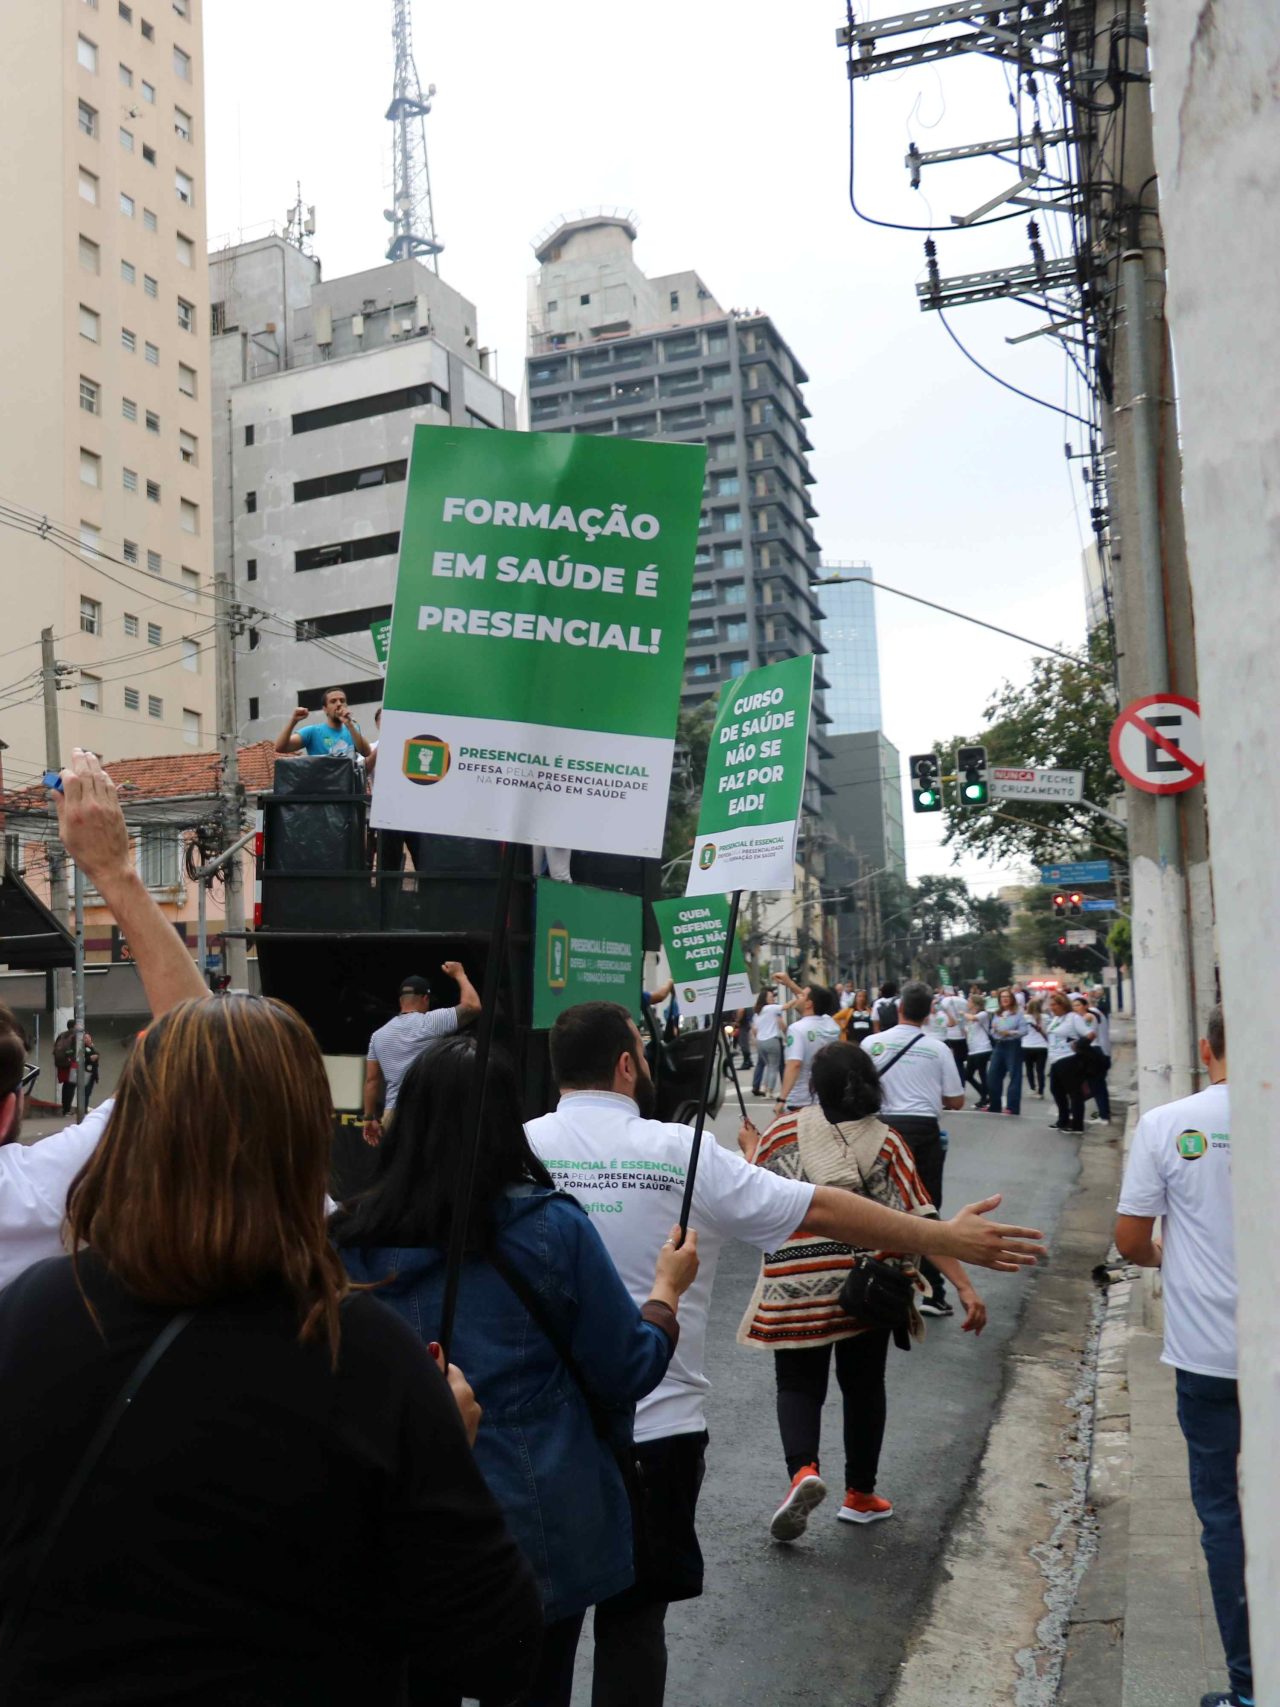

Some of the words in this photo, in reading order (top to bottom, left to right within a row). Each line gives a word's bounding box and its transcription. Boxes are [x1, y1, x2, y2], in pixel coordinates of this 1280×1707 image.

[443, 497, 660, 542] FORMAÇÃO
[432, 551, 486, 579] EM
[496, 555, 624, 594] SAÚDE
[635, 564, 658, 597] É
[417, 606, 662, 654] PRESENCIAL!
[734, 688, 784, 715] CURSO
[720, 724, 739, 744] DE
[741, 711, 795, 738] SAÚDE
[459, 747, 550, 767] PRESENCIAL
[555, 755, 563, 768] É
[567, 759, 649, 777] ESSENCIAL
[725, 742, 755, 766] NÃO
[760, 739, 782, 758] SE
[458, 763, 503, 774] DEFESA
[507, 767, 534, 777] PELA
[538, 772, 648, 791] PRESENCIALIDADE
[476, 775, 492, 784] NA
[496, 777, 561, 792] FORMAÇÃO
[566, 786, 582, 795] EM
[586, 788, 627, 799] SAÚDE
[718, 773, 744, 793] FAZ
[747, 765, 784, 786] POR
[995, 771, 1033, 780] NUNCA
[1041, 775, 1075, 784] FECHE
[1001, 785, 1075, 796] CRUZAMENTO
[728, 794, 765, 815] EAD!
[755, 836, 784, 846] ESSENCIAL
[679, 908, 710, 921] QUEM
[673, 920, 722, 934] DEFENDE
[672, 939, 681, 948] O
[683, 935, 704, 946] SUS
[686, 946, 724, 959] ACEITA
[696, 959, 719, 971] EAD
[543, 1160, 606, 1170] RESENCIAL
[610, 1159, 617, 1168] É
[621, 1161, 685, 1176] ESSENCIAL
[564, 1181, 618, 1190] FORMAÇÃO
[640, 1181, 672, 1191] SAÚDE
